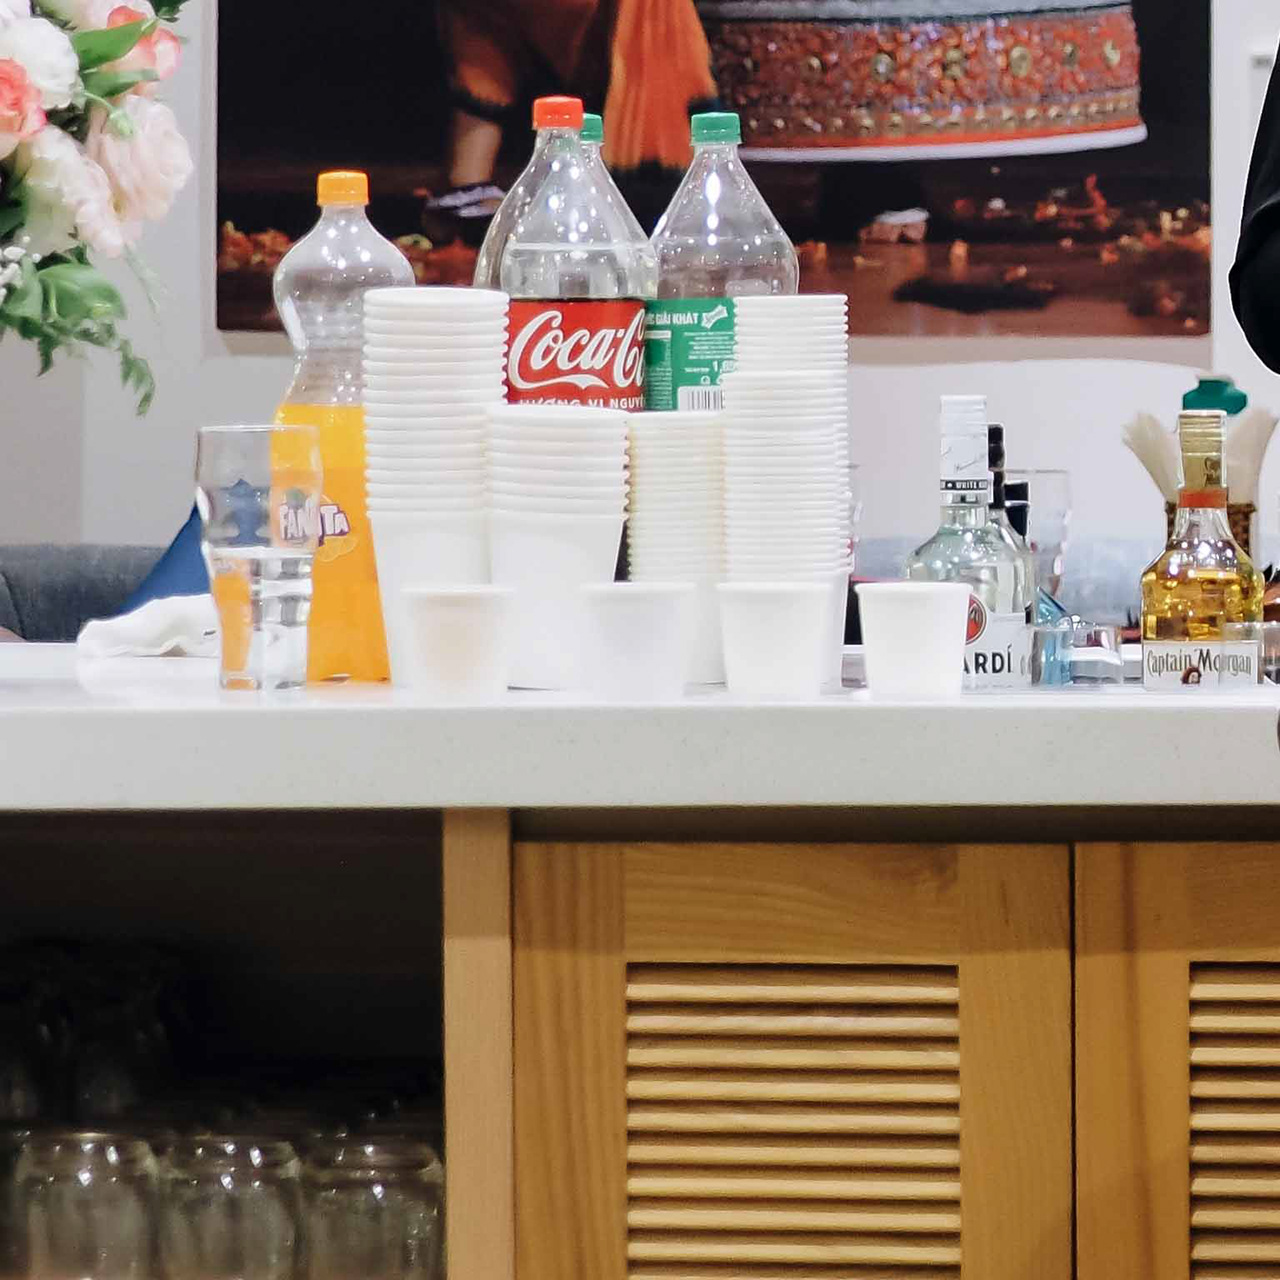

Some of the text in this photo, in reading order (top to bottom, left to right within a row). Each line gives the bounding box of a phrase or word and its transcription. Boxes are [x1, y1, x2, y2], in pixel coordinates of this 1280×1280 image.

[508, 308, 645, 389] Coca-C
[962, 644, 1014, 675] ARDÍ
[1147, 649, 1192, 677] Captain
